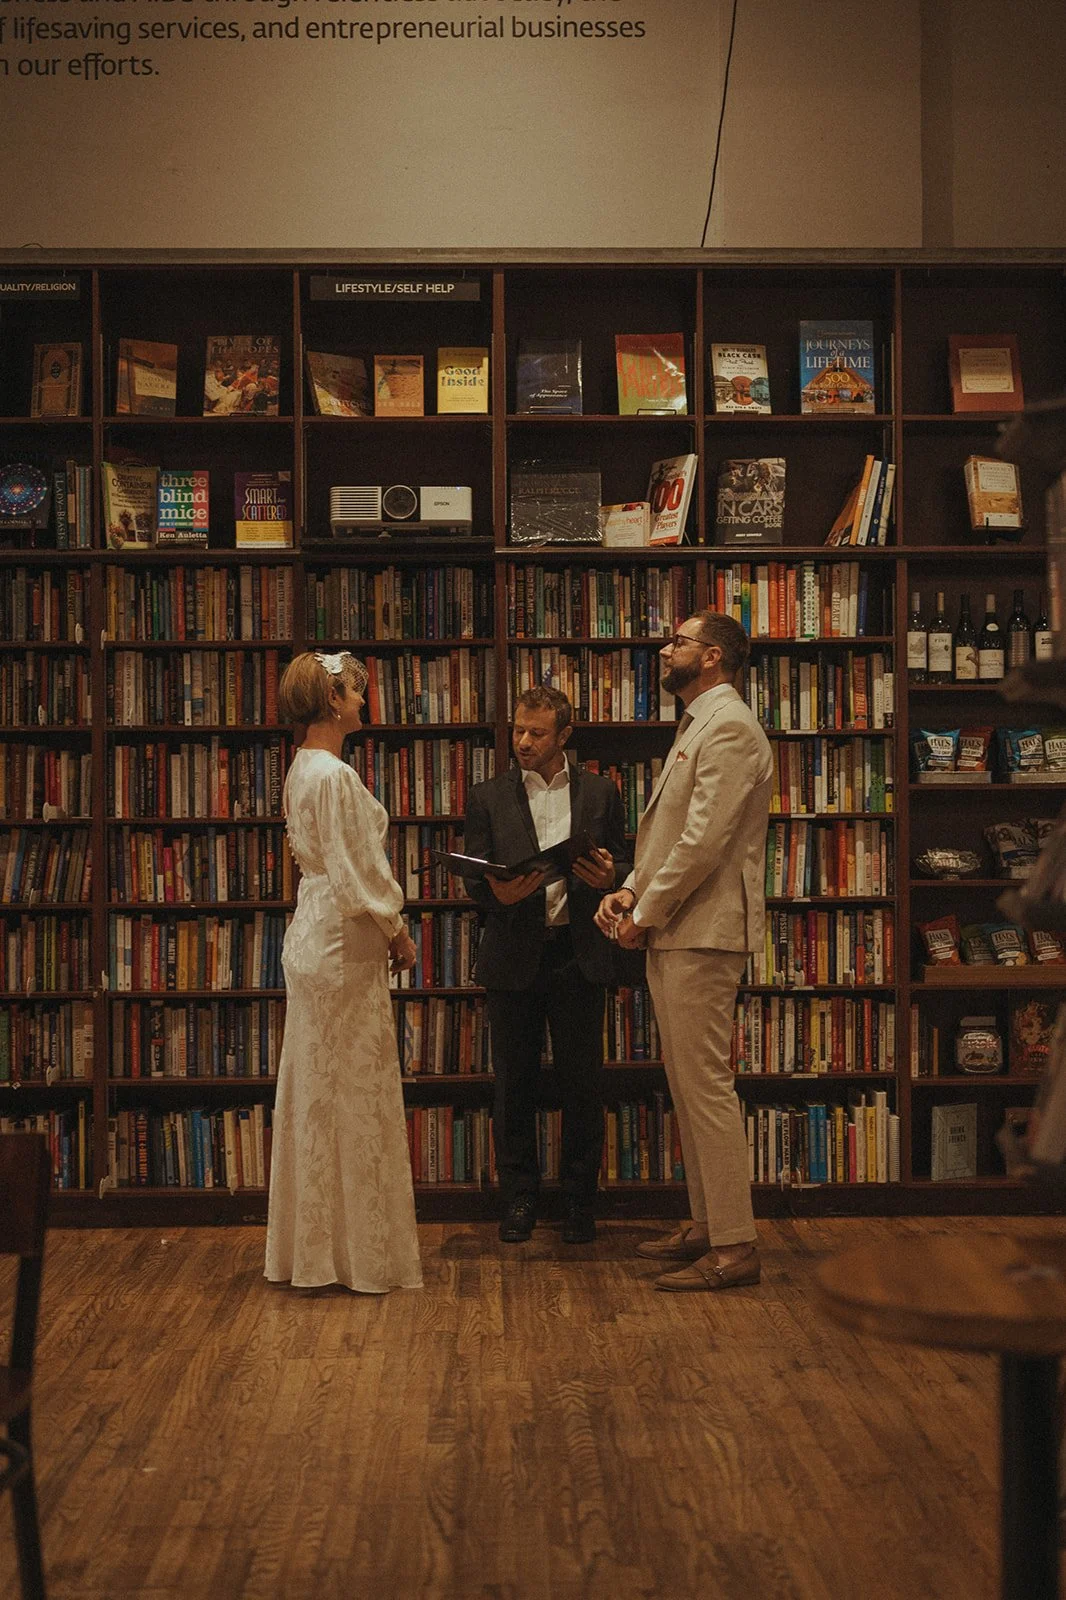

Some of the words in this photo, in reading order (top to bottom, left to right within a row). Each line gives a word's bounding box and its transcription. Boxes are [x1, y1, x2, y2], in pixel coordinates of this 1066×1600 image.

[14, 15, 131, 45] lifesaving
[138, 16, 246, 42] services,
[252, 16, 300, 39] and
[306, 15, 504, 45] entrepreneurial
[512, 15, 646, 38] businesses
[17, 58, 61, 76] our
[67, 53, 160, 81] efforts.
[0, 282, 76, 292] UALITY/RELIGION
[335, 283, 423, 293] LIFESTYLE/SELF
[425, 283, 455, 293] HELP
[805, 338, 871, 353] JOURNEYS
[806, 356, 871, 369] LIFETIME
[444, 365, 482, 376] Good
[441, 376, 485, 388] Inside
[825, 372, 851, 387] 500
[160, 474, 208, 488] three
[159, 489, 208, 504] blind
[245, 487, 278, 505] SMART
[159, 505, 208, 520] mice
[241, 504, 287, 521] SCATTERED
[717, 500, 736, 517] IN
[738, 500, 784, 517] CARS
[716, 515, 752, 524] GETTING
[752, 515, 783, 524] COFFEE
[831, 597, 841, 624] HEART
[855, 672, 867, 713] BASKETBALL
[270, 746, 281, 805] Remodelista
[779, 912, 788, 944] POSSIBLE
[783, 1118, 789, 1128] WE
